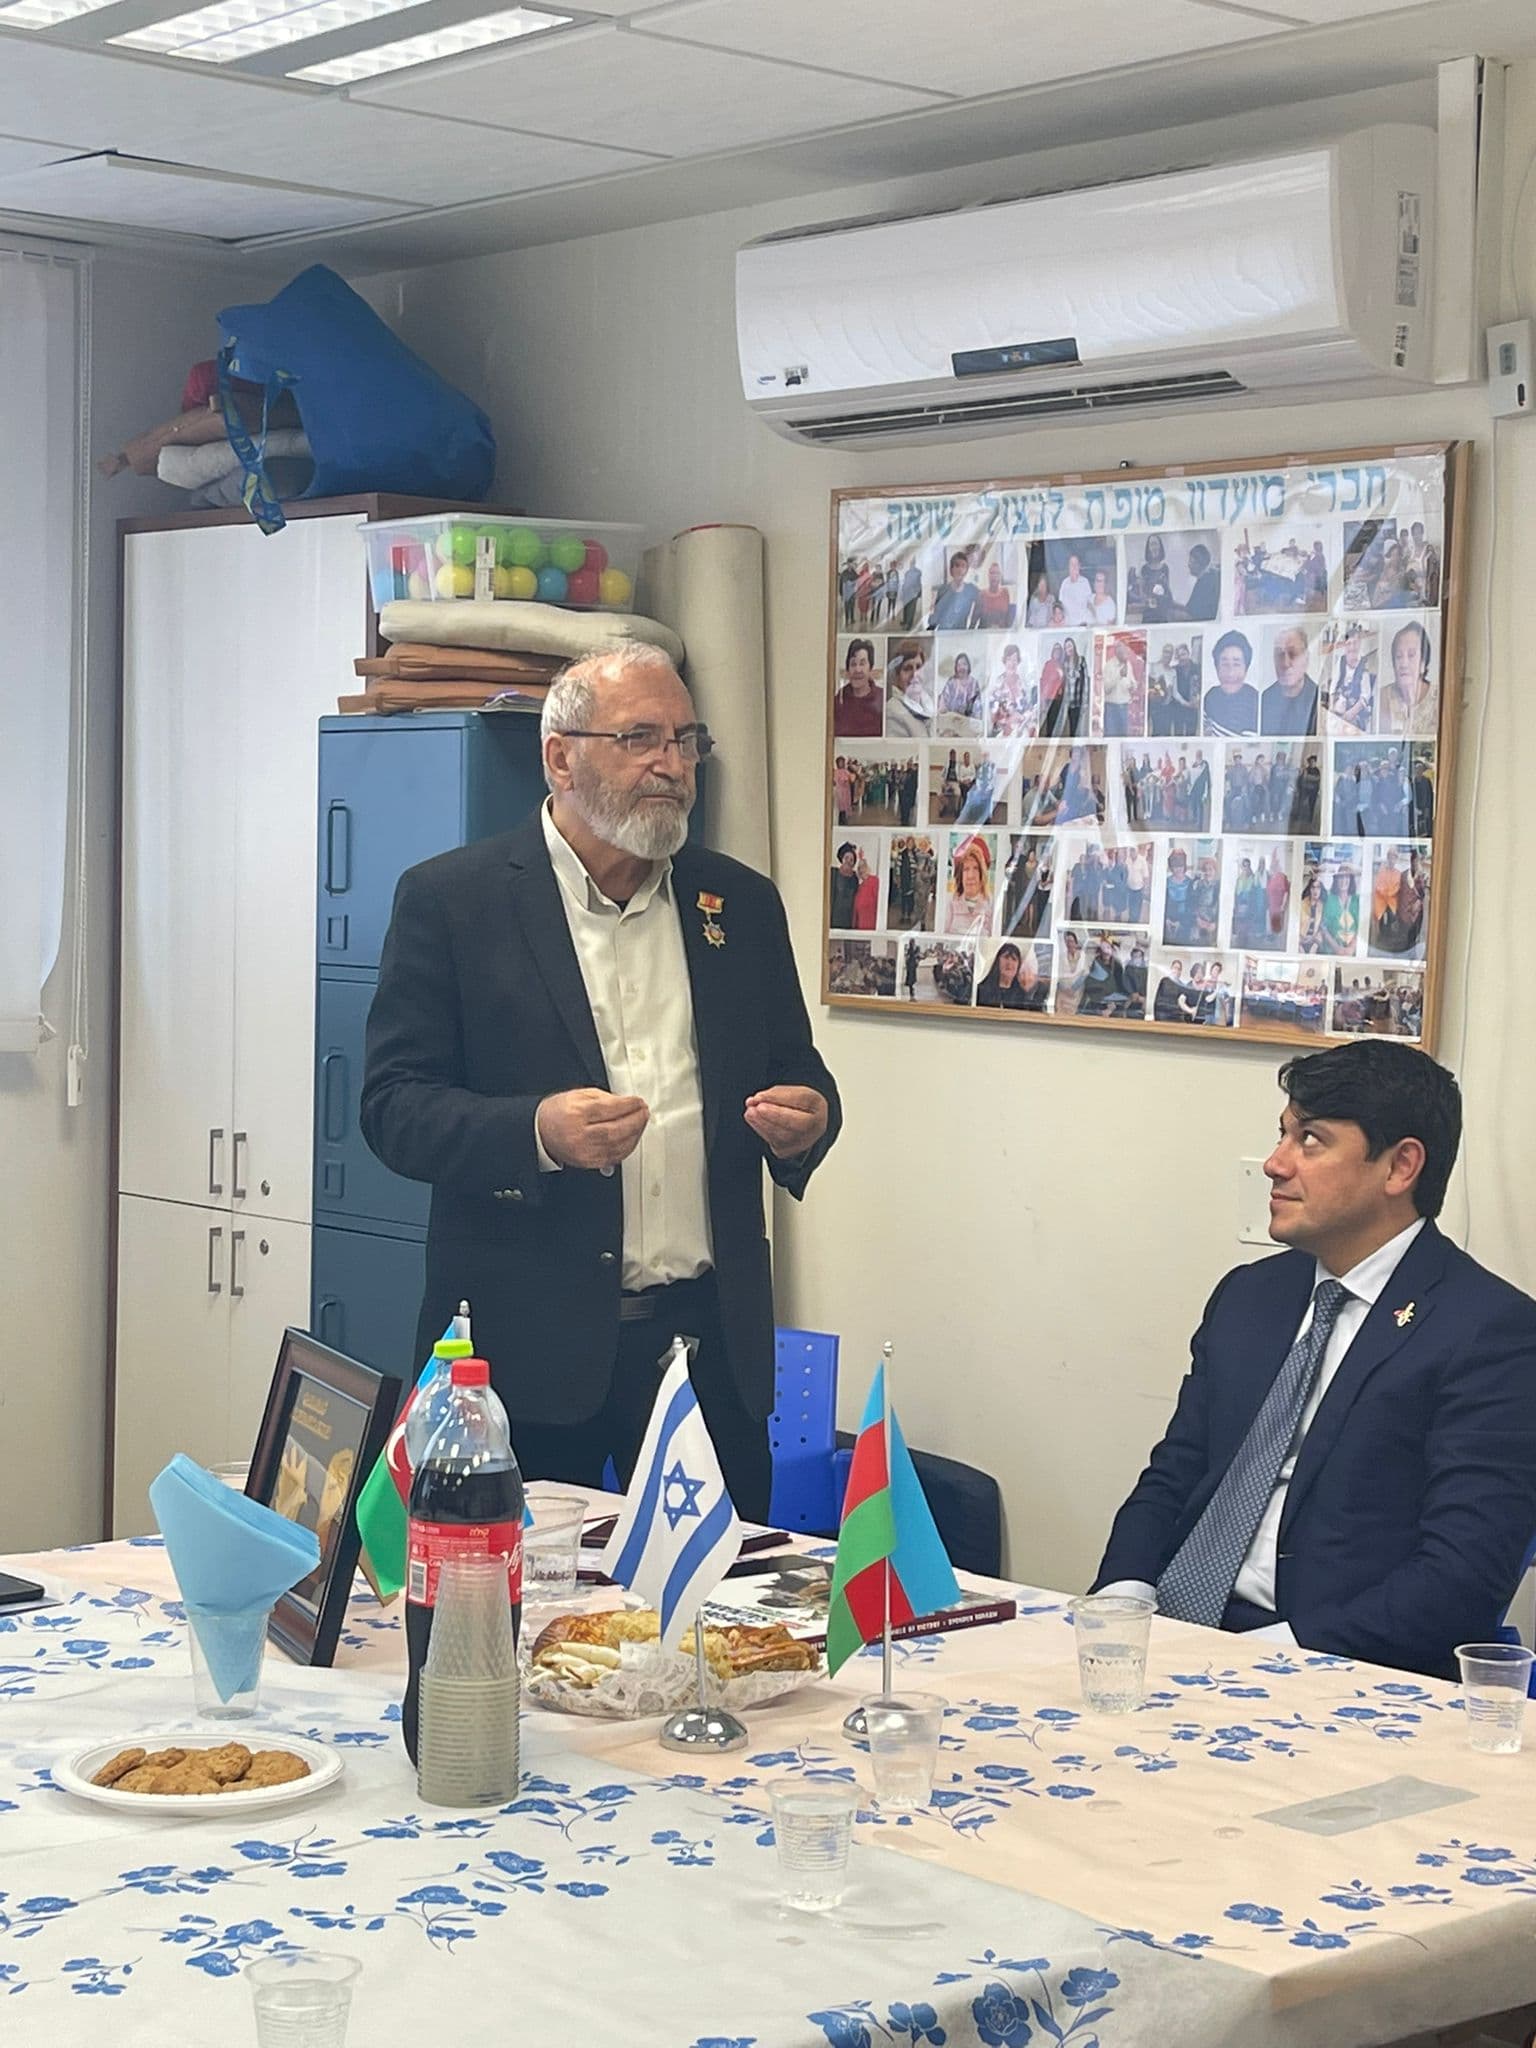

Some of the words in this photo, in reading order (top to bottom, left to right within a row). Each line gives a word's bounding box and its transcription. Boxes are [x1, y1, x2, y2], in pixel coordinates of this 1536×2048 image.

[1084, 486, 1165, 530] מופת
[1186, 474, 1285, 527] מועדון
[1306, 465, 1386, 512] חברי
[887, 500, 956, 541] שואה
